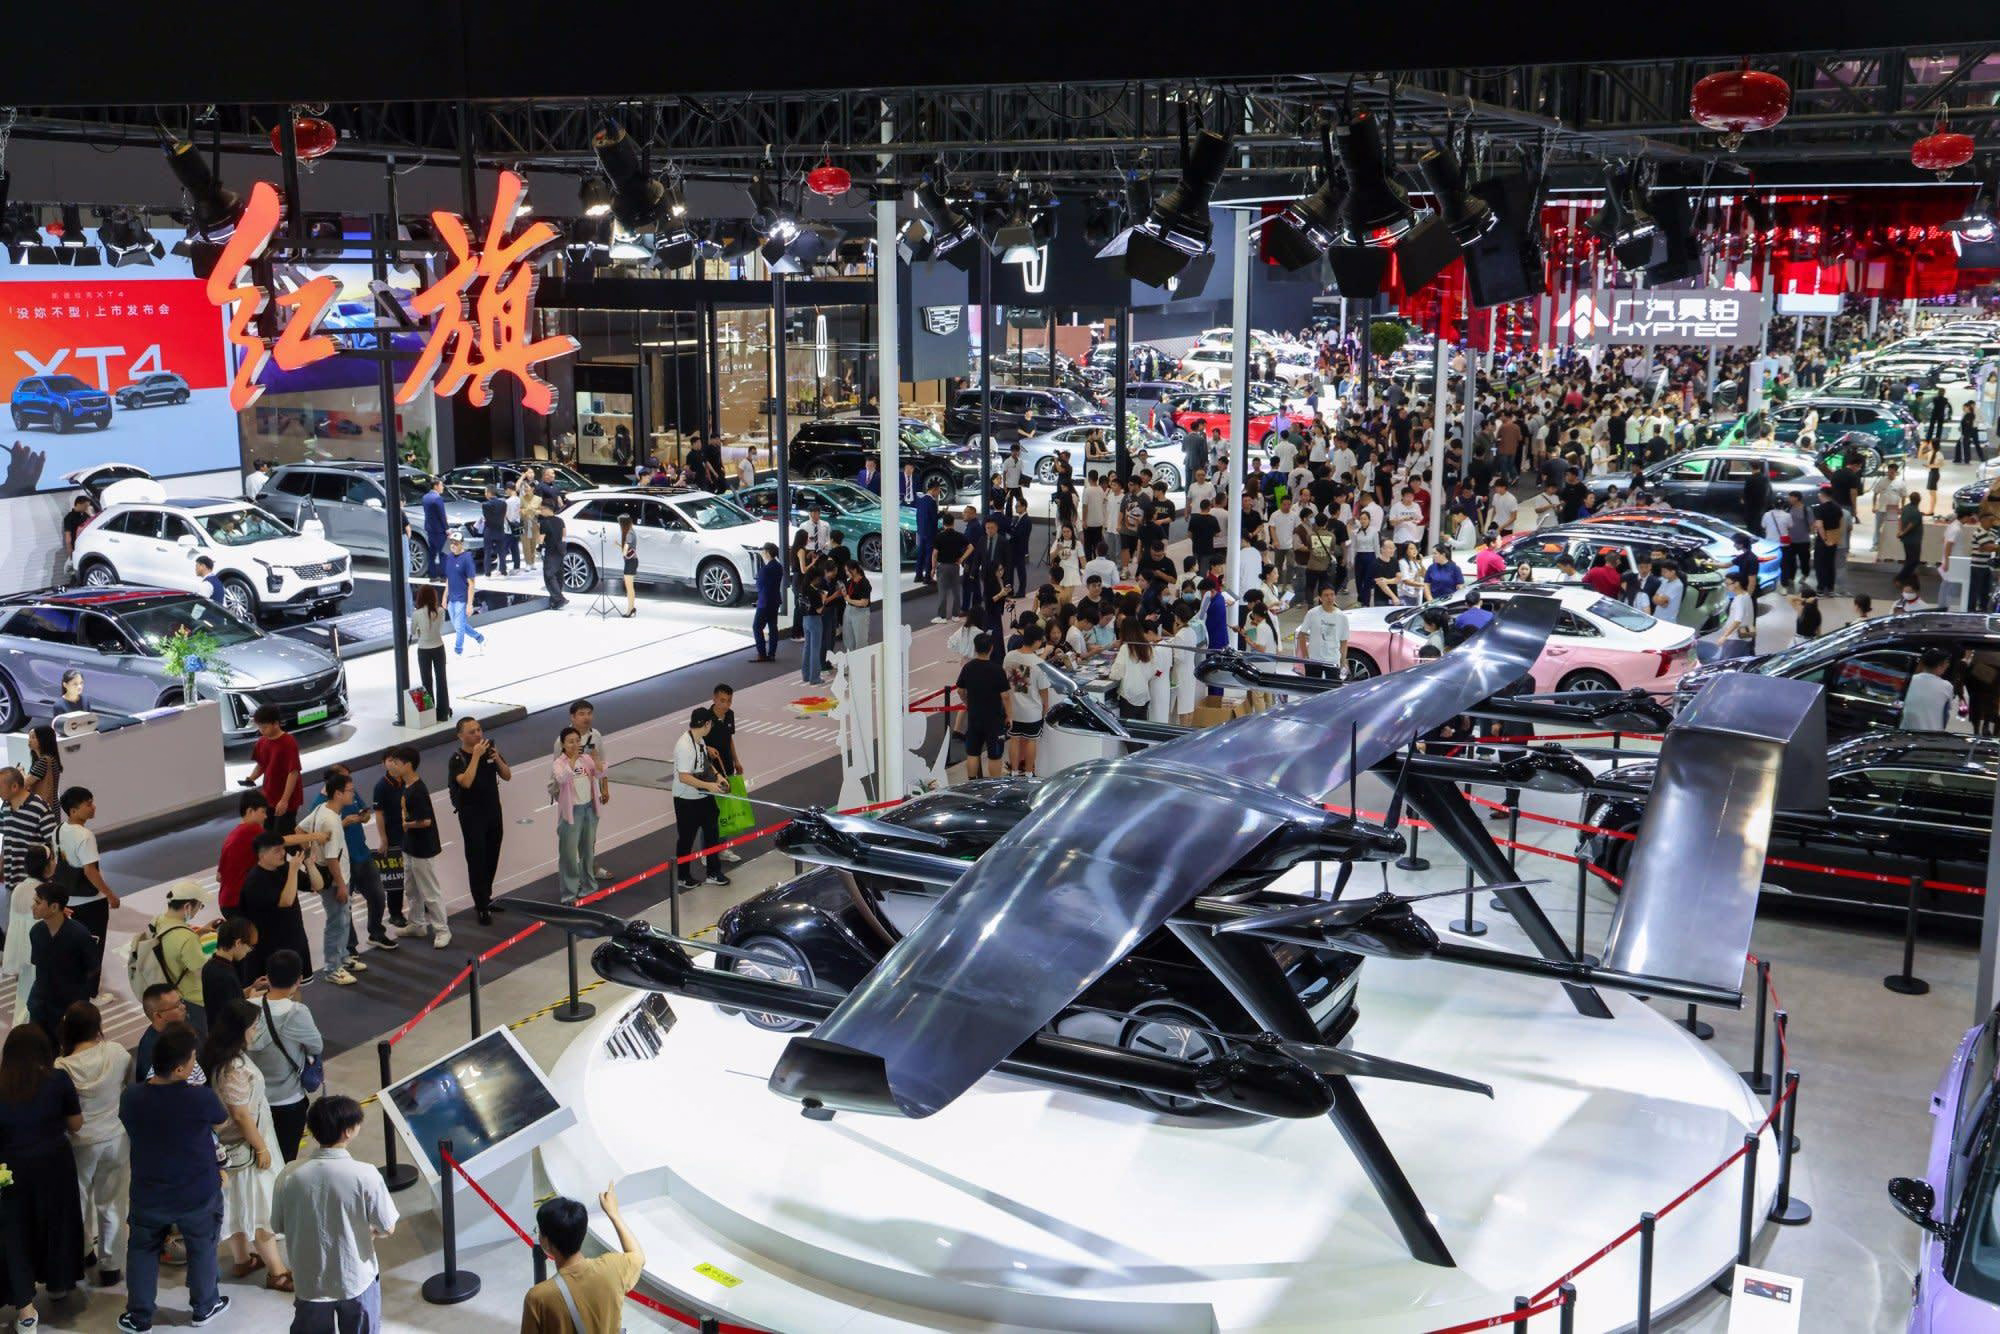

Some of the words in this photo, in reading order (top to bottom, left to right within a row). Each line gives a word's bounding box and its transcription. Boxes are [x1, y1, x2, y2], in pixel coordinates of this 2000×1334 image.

[206, 171, 582, 415] 红旗
[1613, 298, 1739, 321] 广汽昊铂
[1611, 322, 1738, 337] HYPTEC
